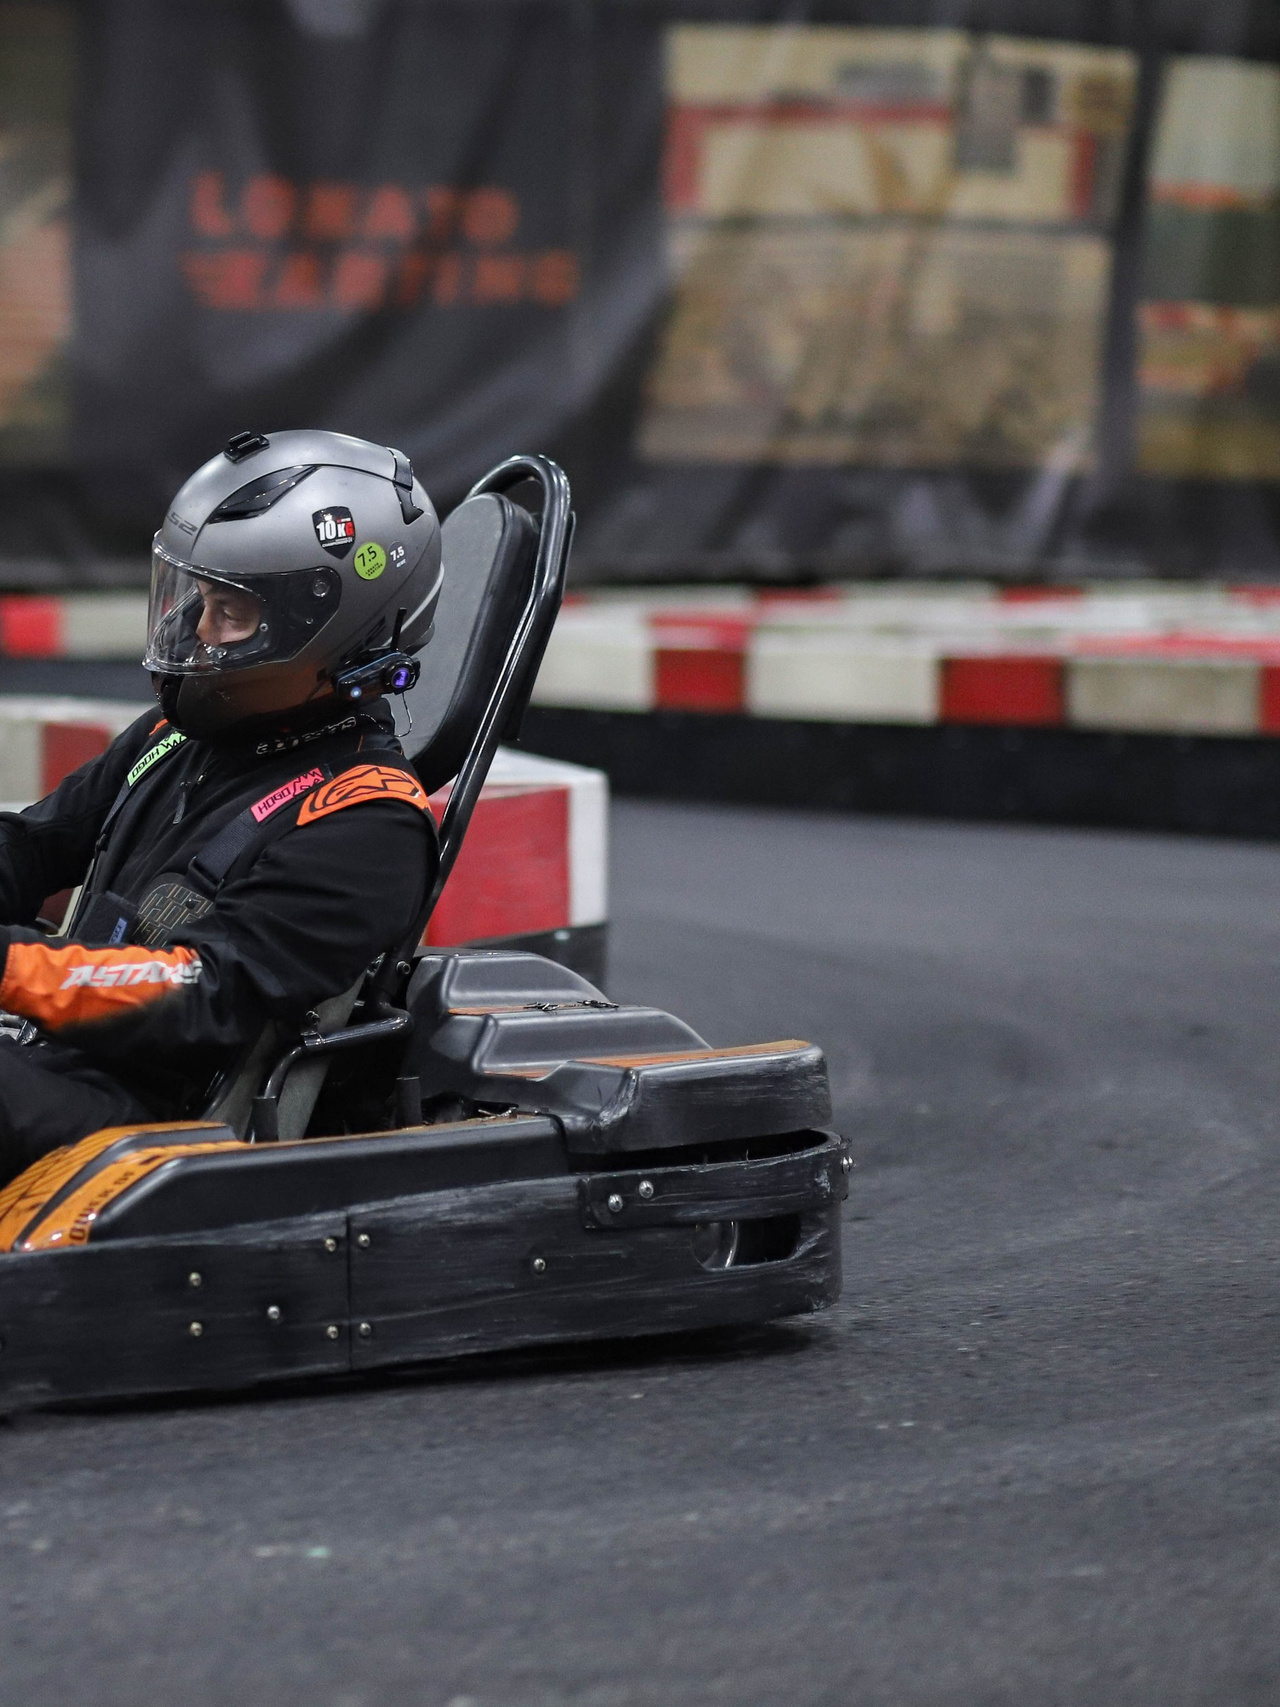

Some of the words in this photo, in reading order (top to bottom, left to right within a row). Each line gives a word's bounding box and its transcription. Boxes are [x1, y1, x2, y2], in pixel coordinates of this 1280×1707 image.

[357, 545, 377, 567] 7.5
[390, 545, 405, 561] 7.5
[131, 747, 160, 778] HOGO
[257, 786, 291, 815] HOGO
[59, 959, 203, 991] ASTARS
